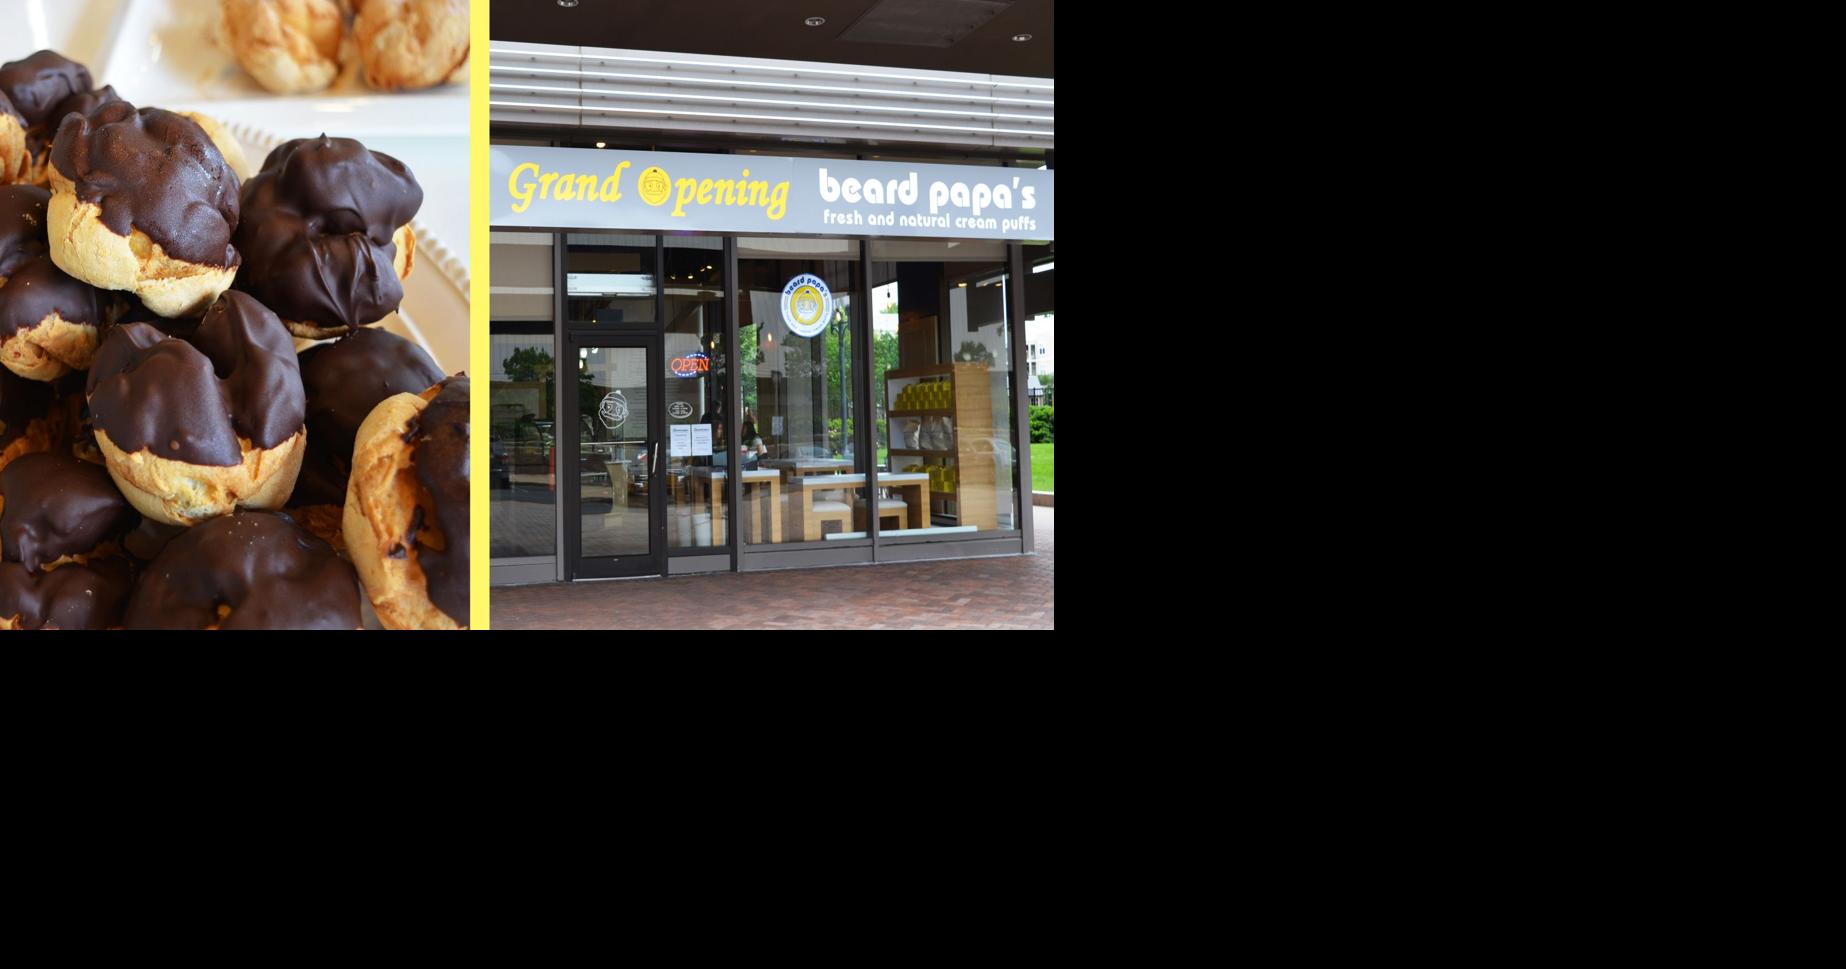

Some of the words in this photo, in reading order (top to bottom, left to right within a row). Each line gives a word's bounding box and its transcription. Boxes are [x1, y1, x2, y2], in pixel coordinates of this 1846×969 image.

[509, 161, 631, 213] Grand
[819, 168, 918, 206] beard
[929, 177, 1036, 216] papa's
[823, 209, 863, 225] fresh
[867, 211, 895, 227] and
[899, 212, 951, 229] natural
[955, 216, 997, 230] cream
[1002, 215, 1037, 233] puffs
[784, 276, 805, 296] beard
[671, 357, 710, 372] OPEN
